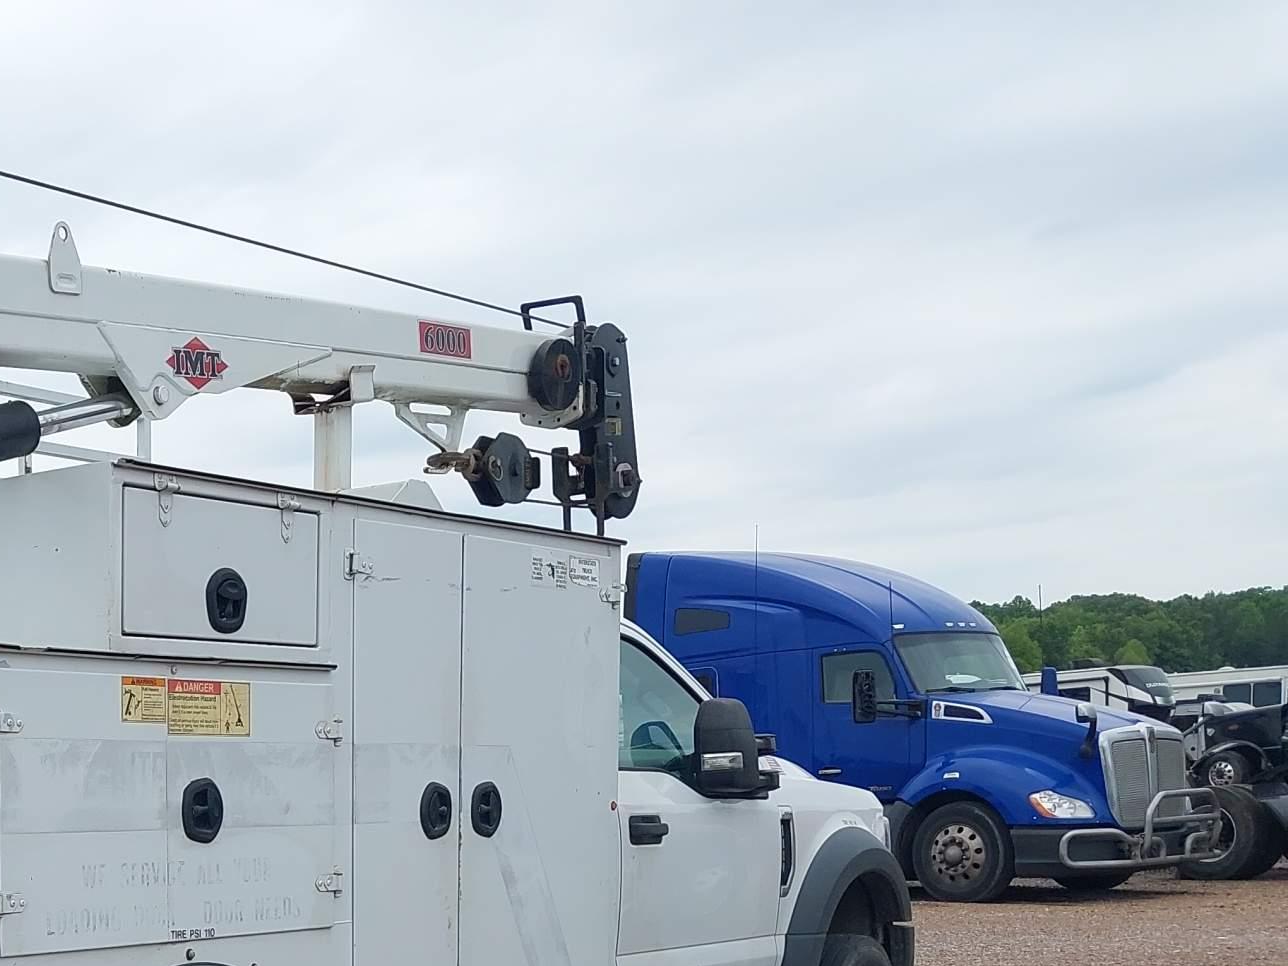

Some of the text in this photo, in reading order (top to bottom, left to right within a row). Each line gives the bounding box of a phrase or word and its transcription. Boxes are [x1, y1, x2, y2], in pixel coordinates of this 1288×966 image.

[424, 325, 467, 355] 6000
[172, 348, 222, 378] IMT
[183, 682, 214, 693] DANGER
[171, 927, 216, 940] TIRE PSI 110
